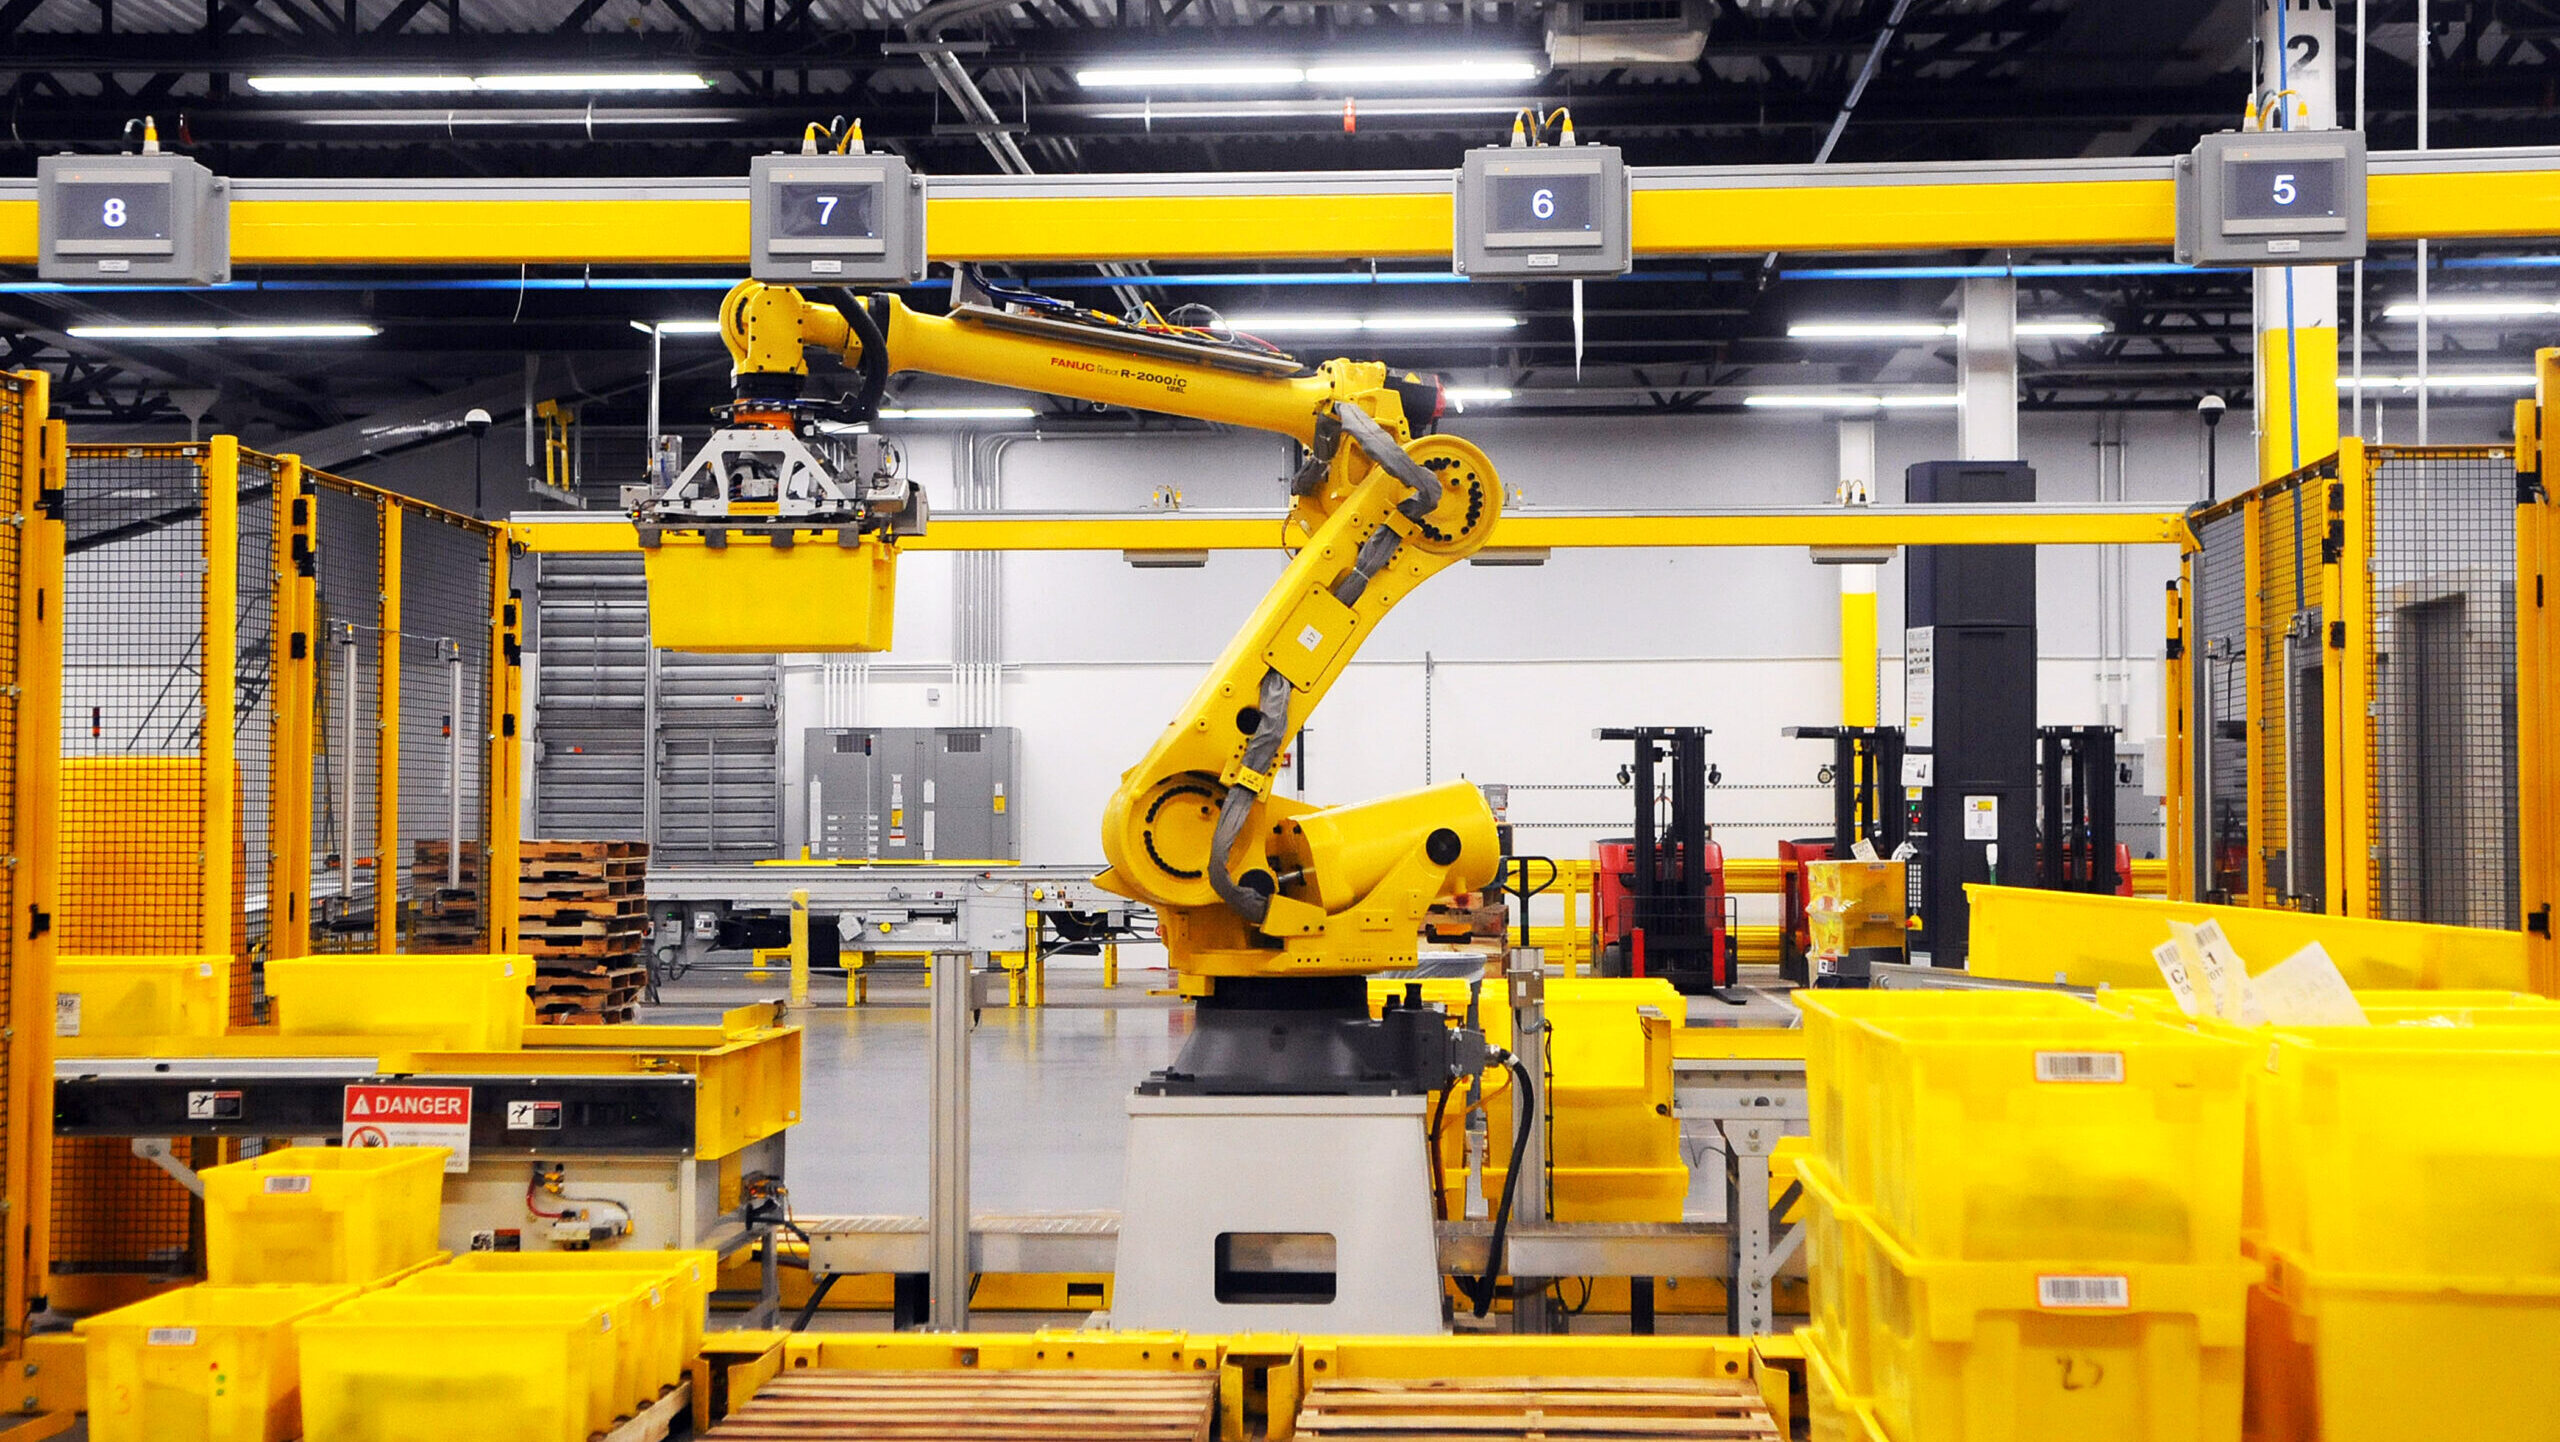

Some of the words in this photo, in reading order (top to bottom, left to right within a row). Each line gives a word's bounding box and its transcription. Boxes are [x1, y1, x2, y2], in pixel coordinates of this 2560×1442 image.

[2286, 34, 2320, 79] 2
[1532, 188, 1555, 219] 6
[2272, 174, 2297, 205] 5
[102, 197, 128, 227] 8
[816, 196, 838, 226] 7
[1050, 357, 1095, 372] FANUC
[1120, 369, 1187, 389] R-2000iC
[374, 1095, 462, 1115] DANGER
